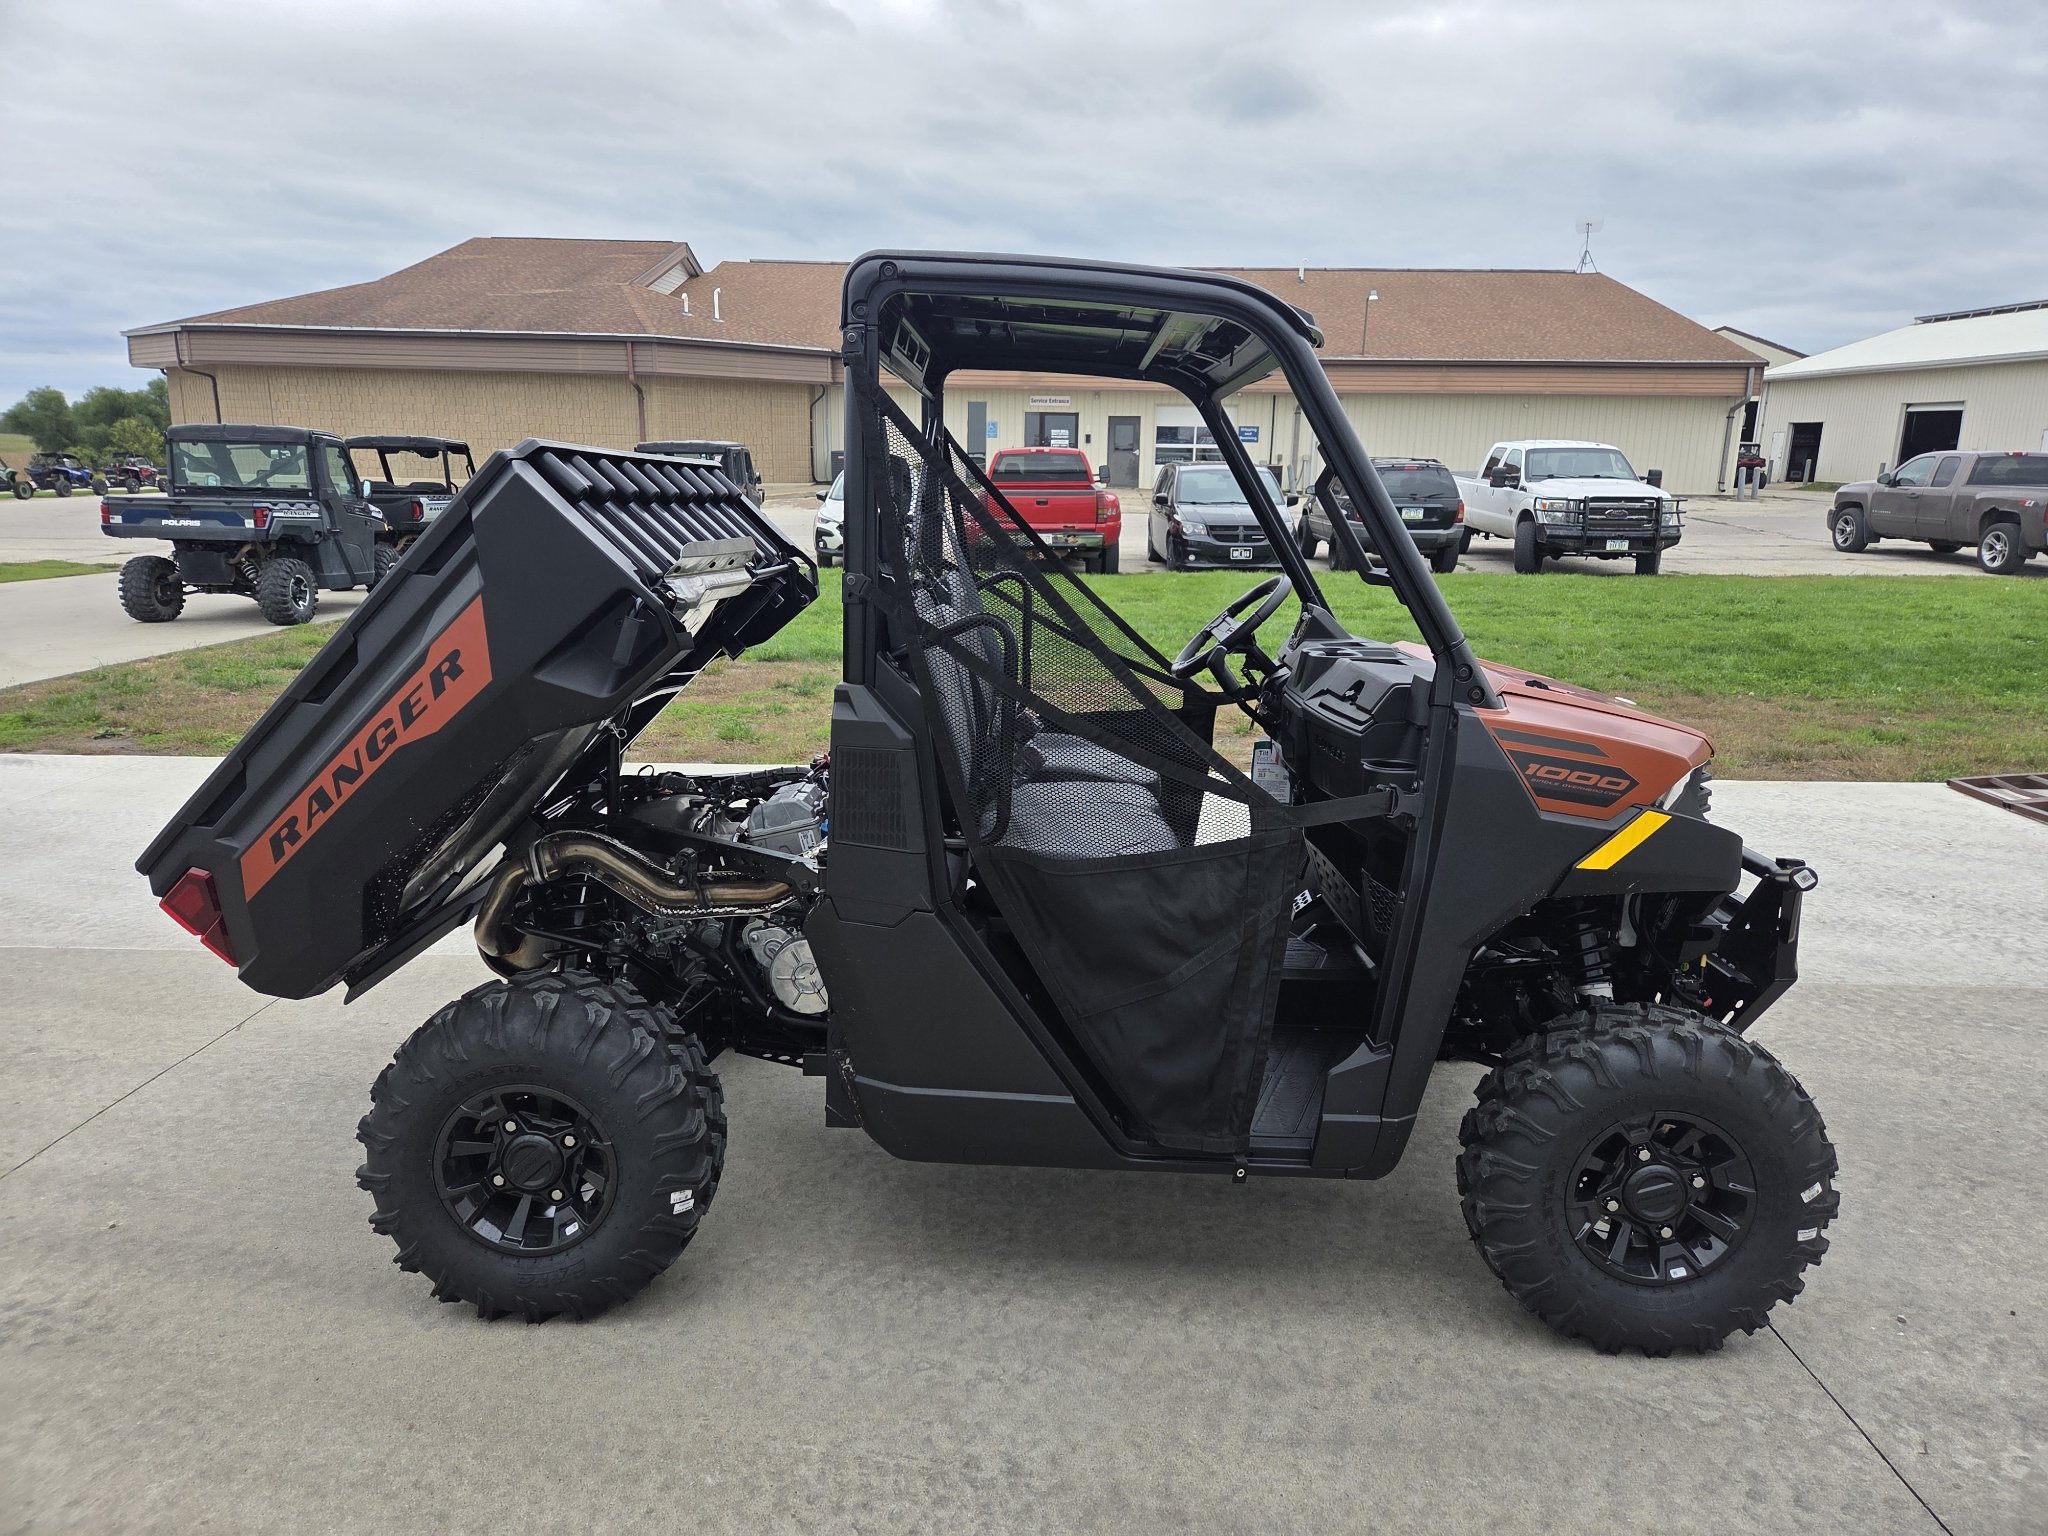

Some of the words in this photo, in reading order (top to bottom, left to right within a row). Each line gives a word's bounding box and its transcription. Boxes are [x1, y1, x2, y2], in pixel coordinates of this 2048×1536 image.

[162, 519, 201, 527] POLARIS
[268, 648, 465, 865] RANGER
[1525, 763, 1631, 791] 1000
